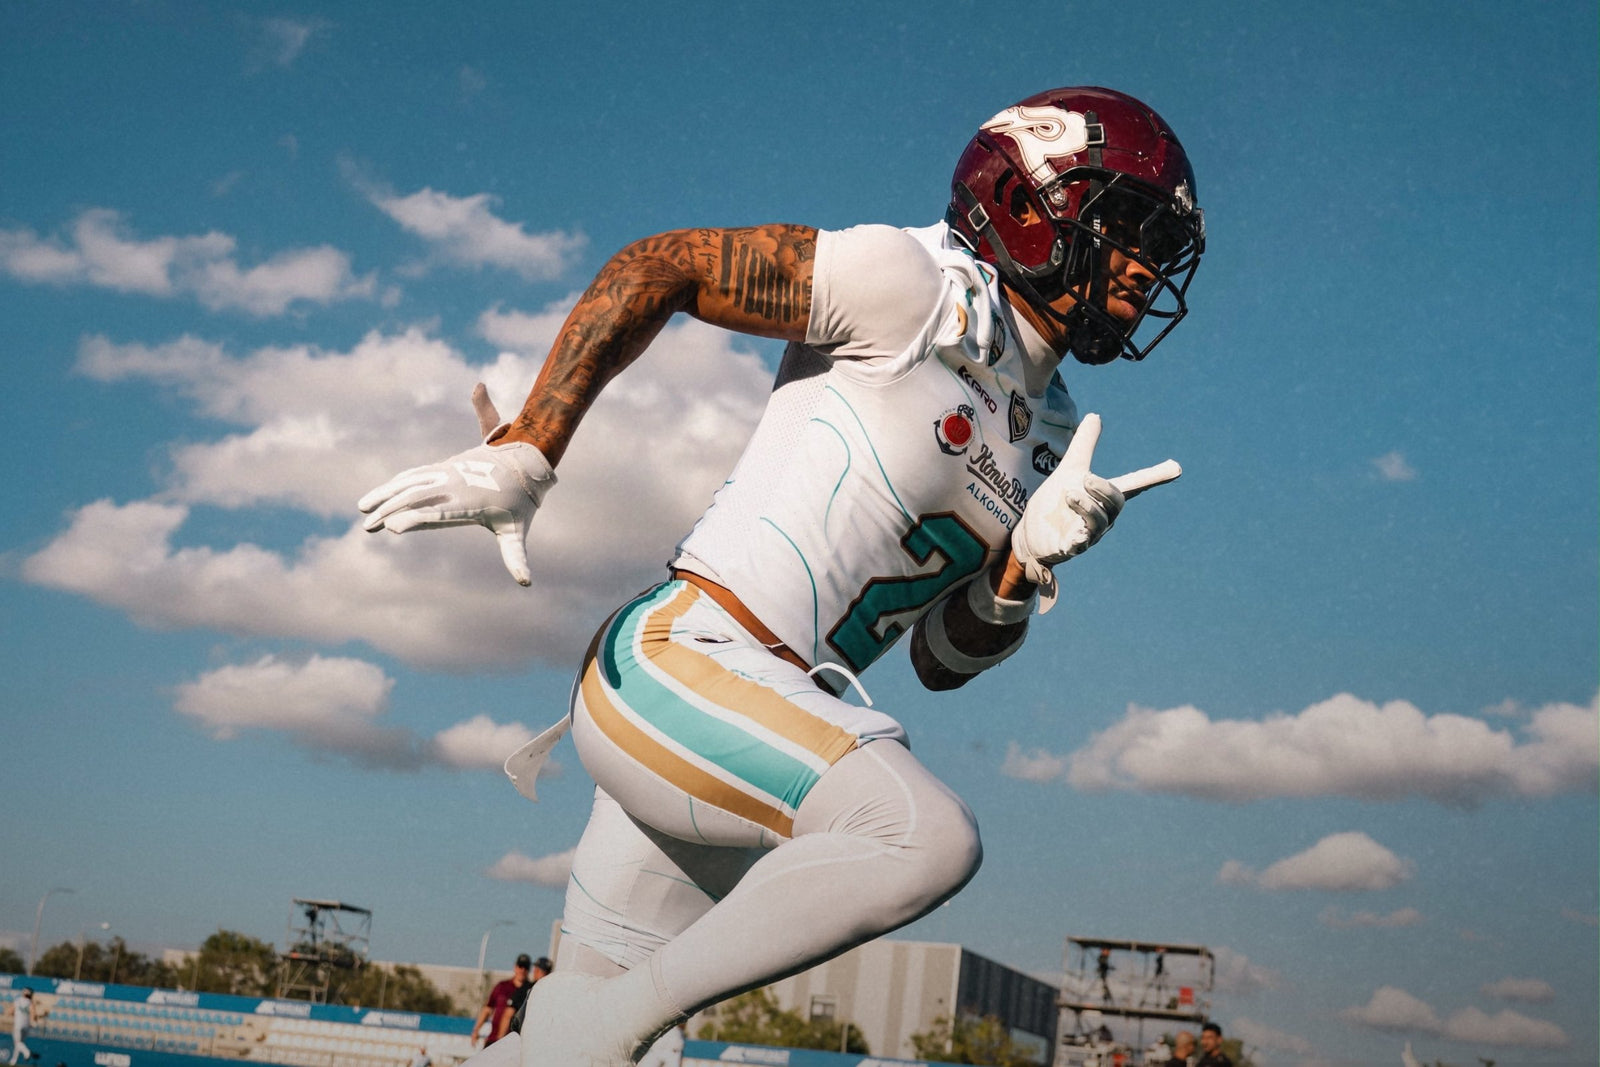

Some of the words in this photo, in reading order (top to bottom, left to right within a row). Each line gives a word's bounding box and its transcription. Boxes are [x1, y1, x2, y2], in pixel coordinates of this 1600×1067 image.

[970, 443, 1011, 498] König
[966, 482, 1013, 530] ALKOHOL
[826, 511, 990, 674] 2
